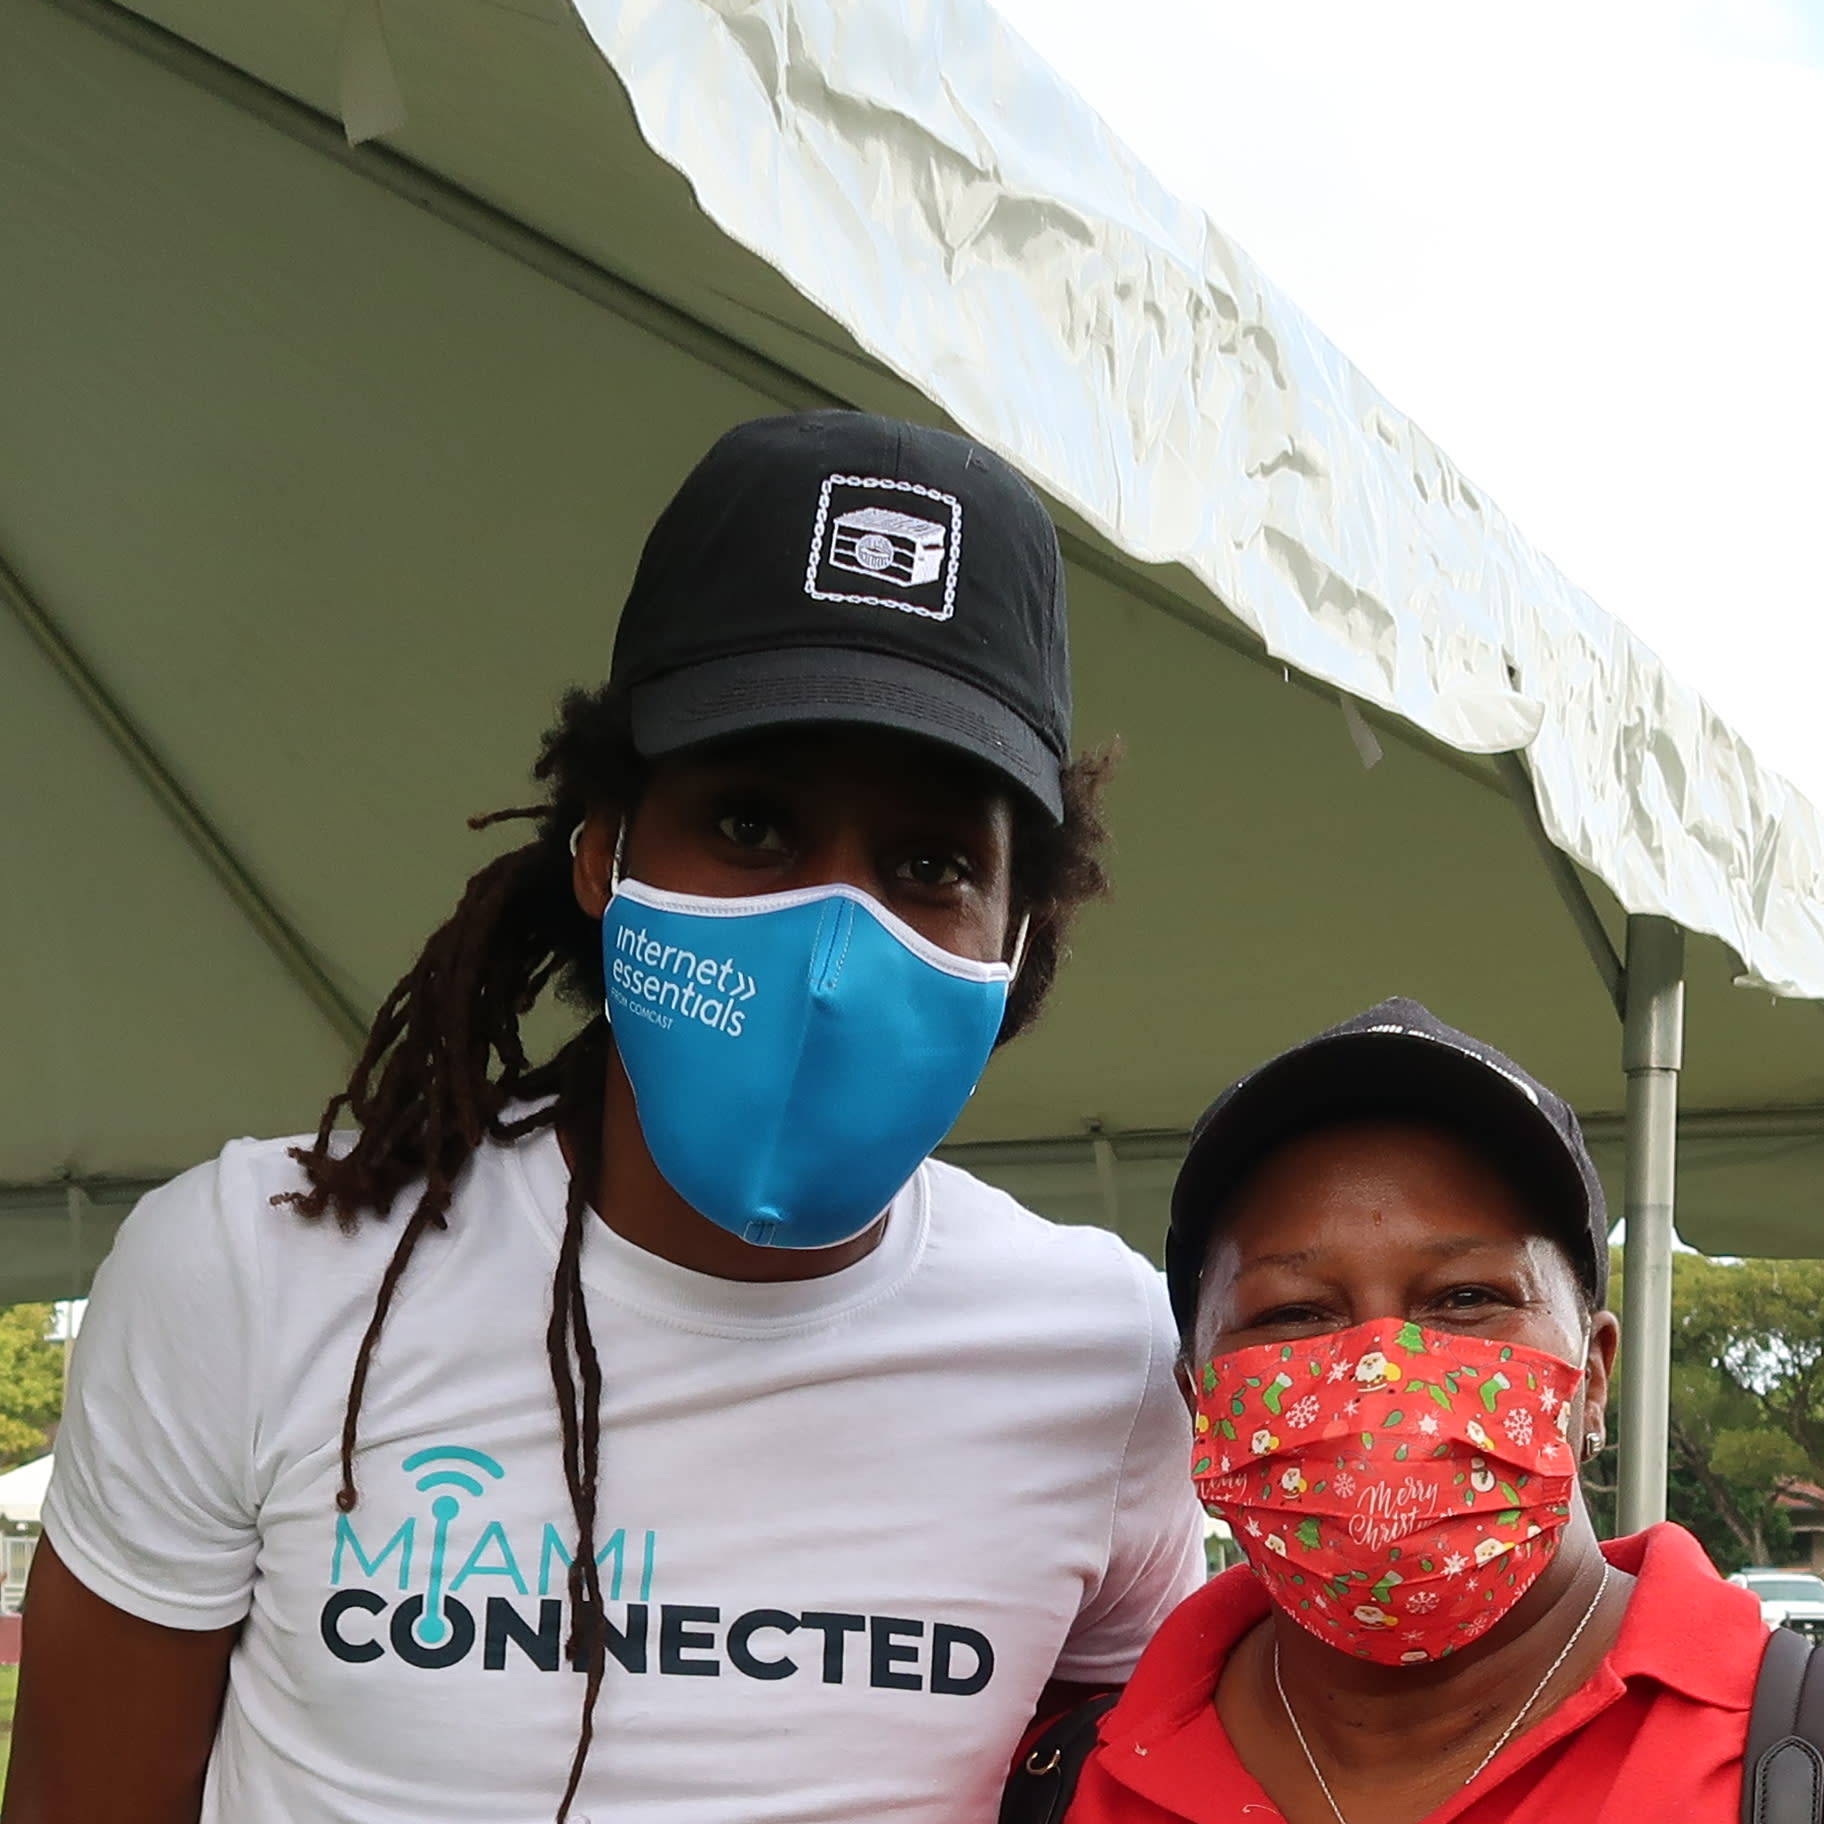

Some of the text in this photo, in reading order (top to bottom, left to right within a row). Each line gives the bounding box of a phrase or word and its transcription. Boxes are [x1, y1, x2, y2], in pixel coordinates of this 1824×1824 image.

[612, 957, 746, 1038] essentials
[629, 1000, 673, 1030] COMCAST
[1356, 1475, 1439, 1519] Merry
[329, 1500, 657, 1604] MIAMI
[320, 1587, 995, 1696] CONNECTED
